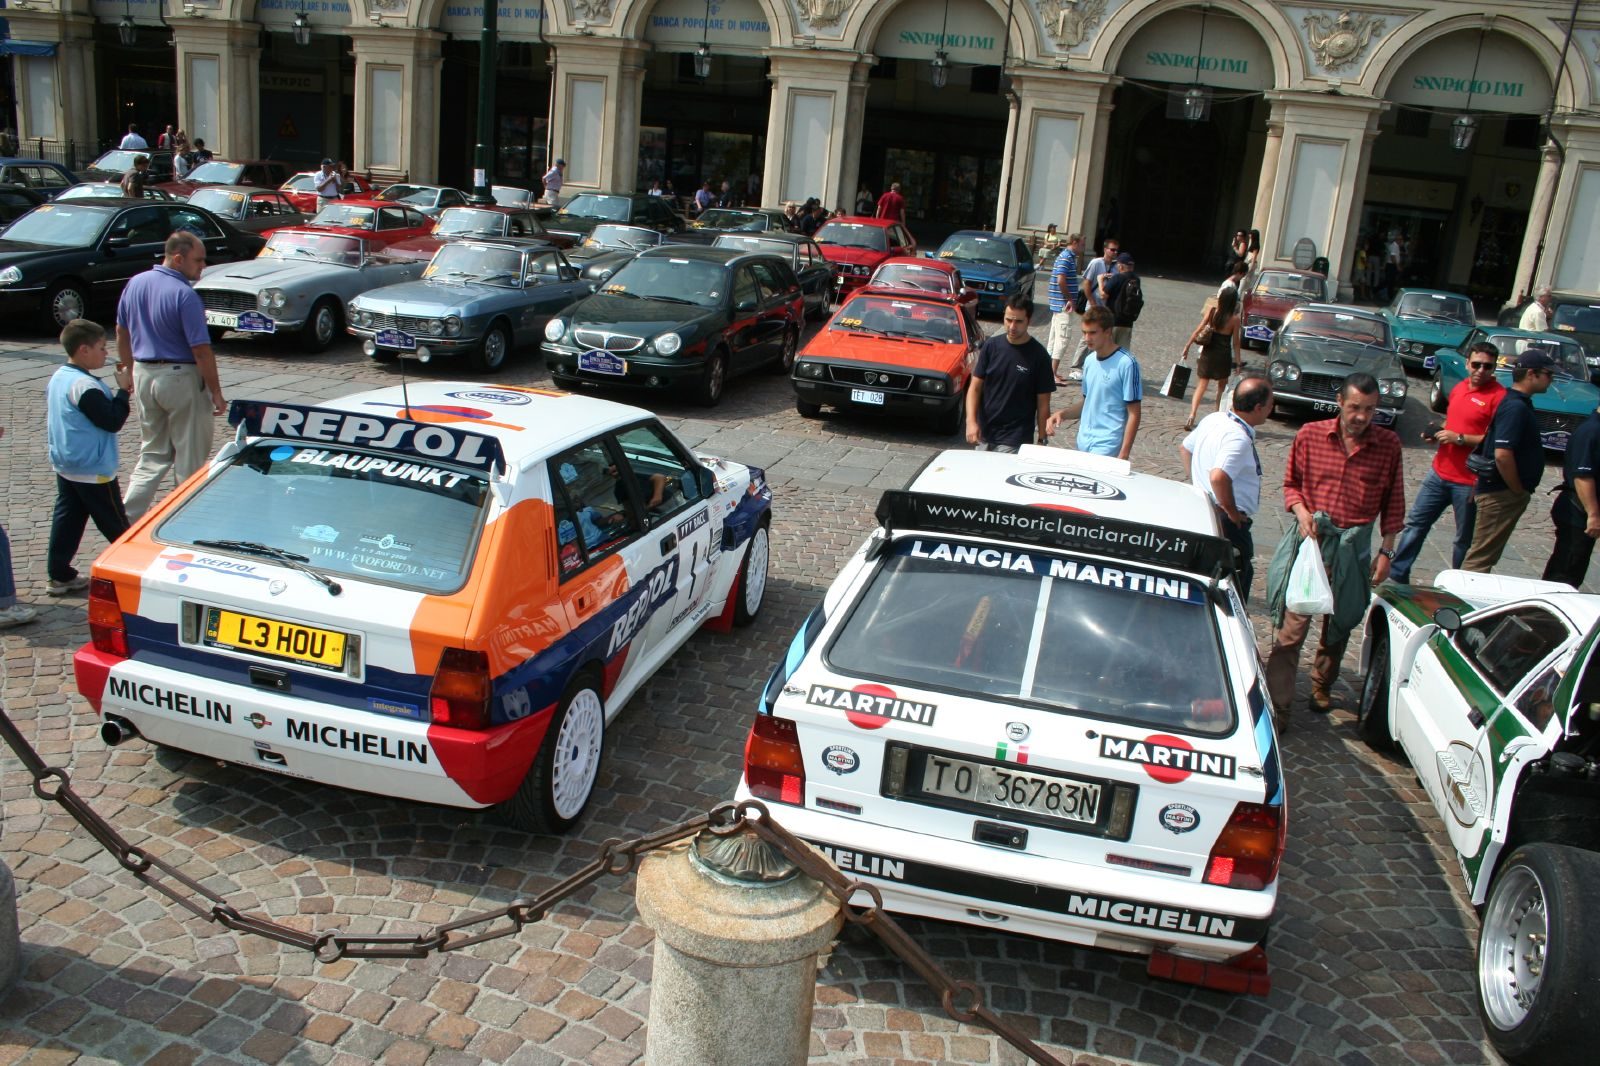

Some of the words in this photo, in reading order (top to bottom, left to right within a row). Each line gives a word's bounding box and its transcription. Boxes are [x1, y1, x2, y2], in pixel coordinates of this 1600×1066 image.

[285, 0, 318, 11] POPOLARE
[321, 2, 330, 11] DI
[447, 6, 471, 16] BANCA
[514, 8, 523, 18] DI
[653, 16, 679, 28] BANCA
[683, 17, 724, 30] POPOLARE
[727, 20, 737, 31] DI
[968, 35, 996, 50] IMI
[1220, 58, 1249, 74] IMI
[259, 75, 312, 88] LYMPIC
[1493, 81, 1525, 98] IMI
[221, 316, 237, 327] 407
[853, 389, 865, 401] TET
[260, 406, 487, 465] REPSOL
[291, 448, 470, 488] BLAUPUNKT
[926, 503, 1189, 554] www.historiclanciarally.it
[196, 555, 258, 574] REPSOL
[910, 540, 1035, 574] LANCIA
[1049, 559, 1190, 600] MARTINI
[606, 560, 675, 658] REPSOL
[238, 617, 271, 648] L3
[276, 625, 327, 659] HOU
[109, 676, 232, 724] MICHELIN
[810, 686, 933, 724] MARTINI
[286, 718, 428, 764] MICHELIN
[829, 754, 853, 765] MARTINI
[1103, 738, 1232, 778] MARTINI
[933, 760, 972, 794] TO
[994, 771, 1099, 821] 36783N
[1166, 813, 1193, 824] MARTINI
[1067, 894, 1236, 939] MICHELIN
